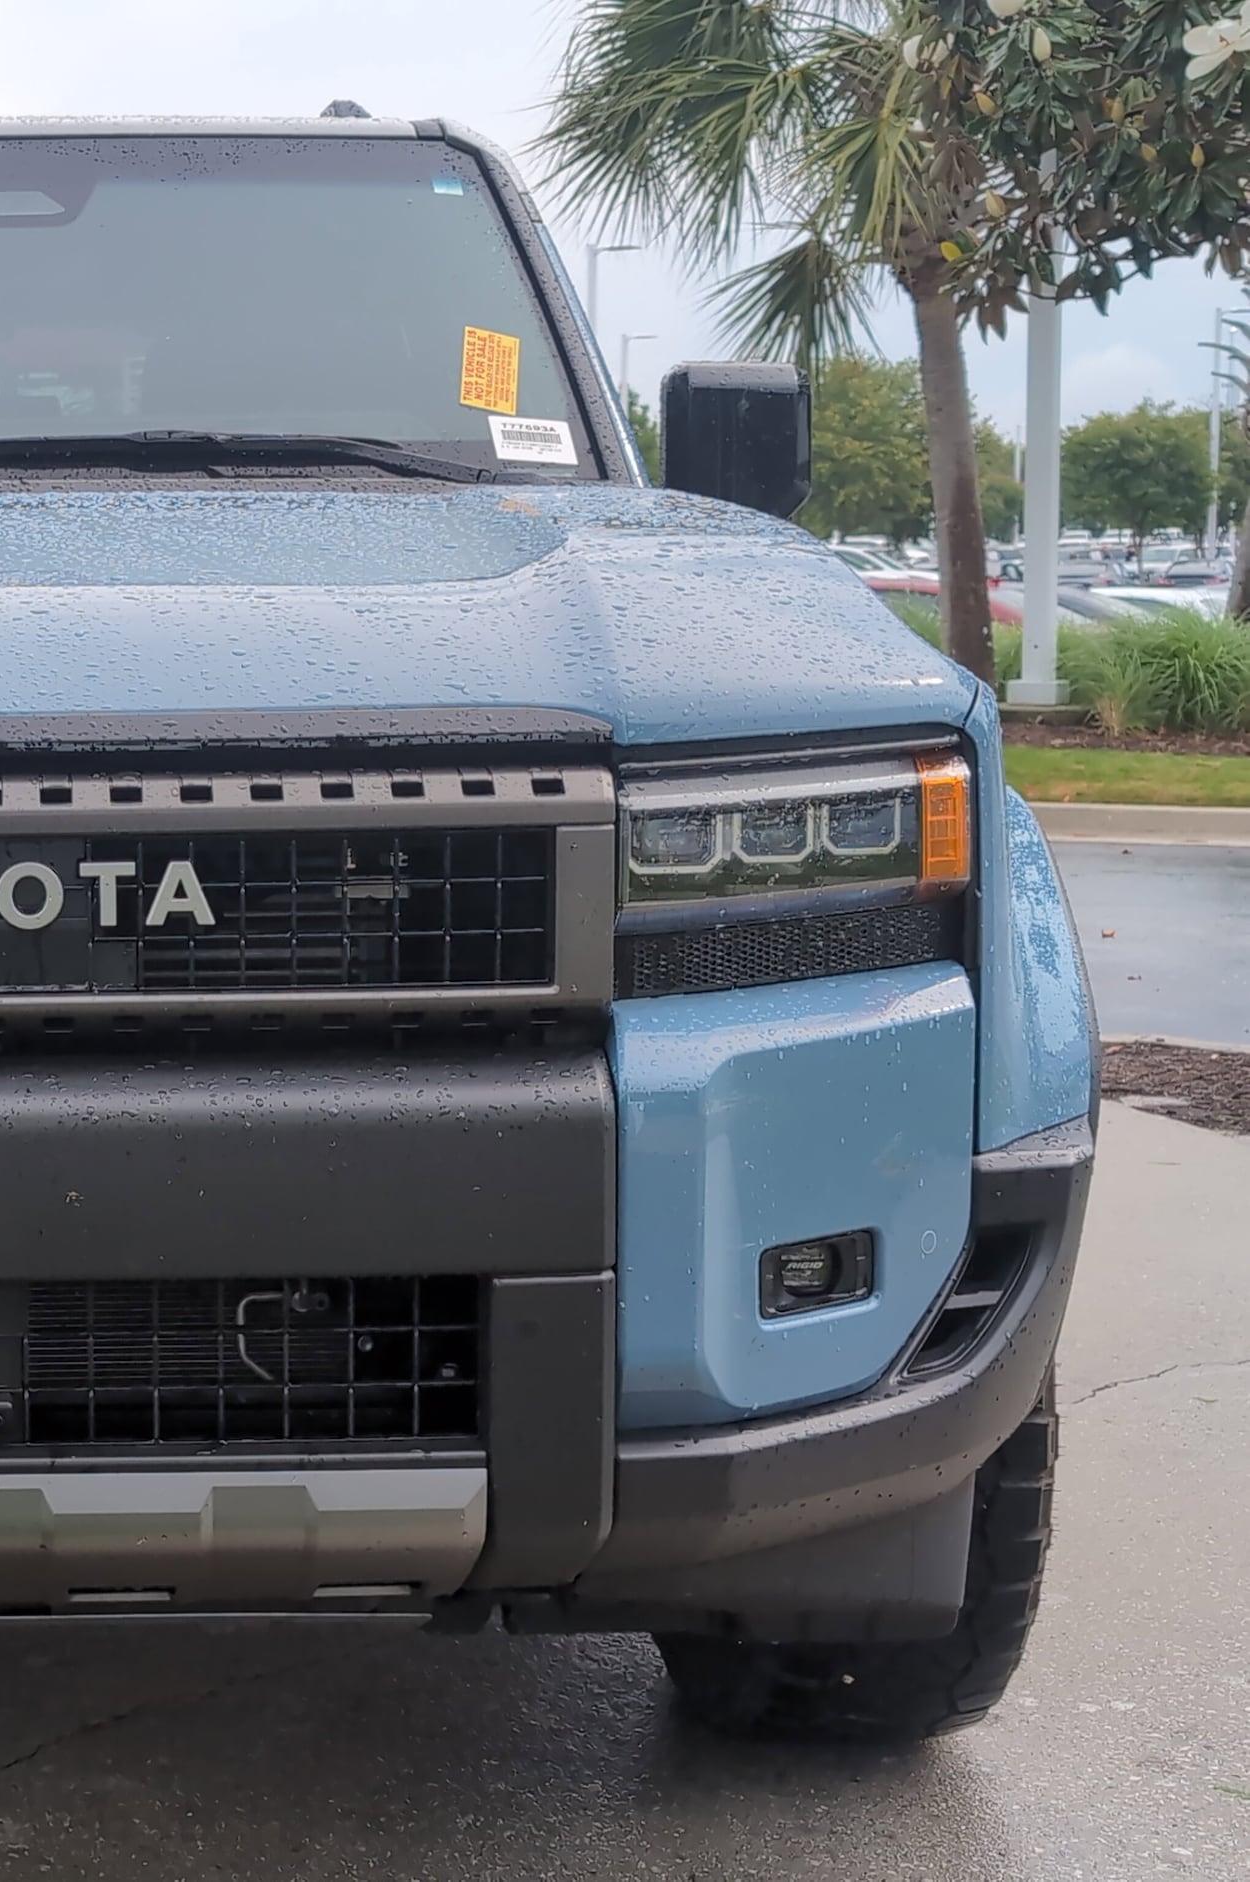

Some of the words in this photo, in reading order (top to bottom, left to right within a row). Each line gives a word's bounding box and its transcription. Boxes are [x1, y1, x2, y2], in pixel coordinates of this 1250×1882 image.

[467, 330, 476, 339] IS
[476, 335, 486, 359] SALE
[464, 340, 475, 378] VEHICLE
[475, 360, 485, 379] FOR
[463, 380, 473, 401] THIS
[474, 380, 483, 400] NOT
[786, 1261, 824, 1270] RIGID
